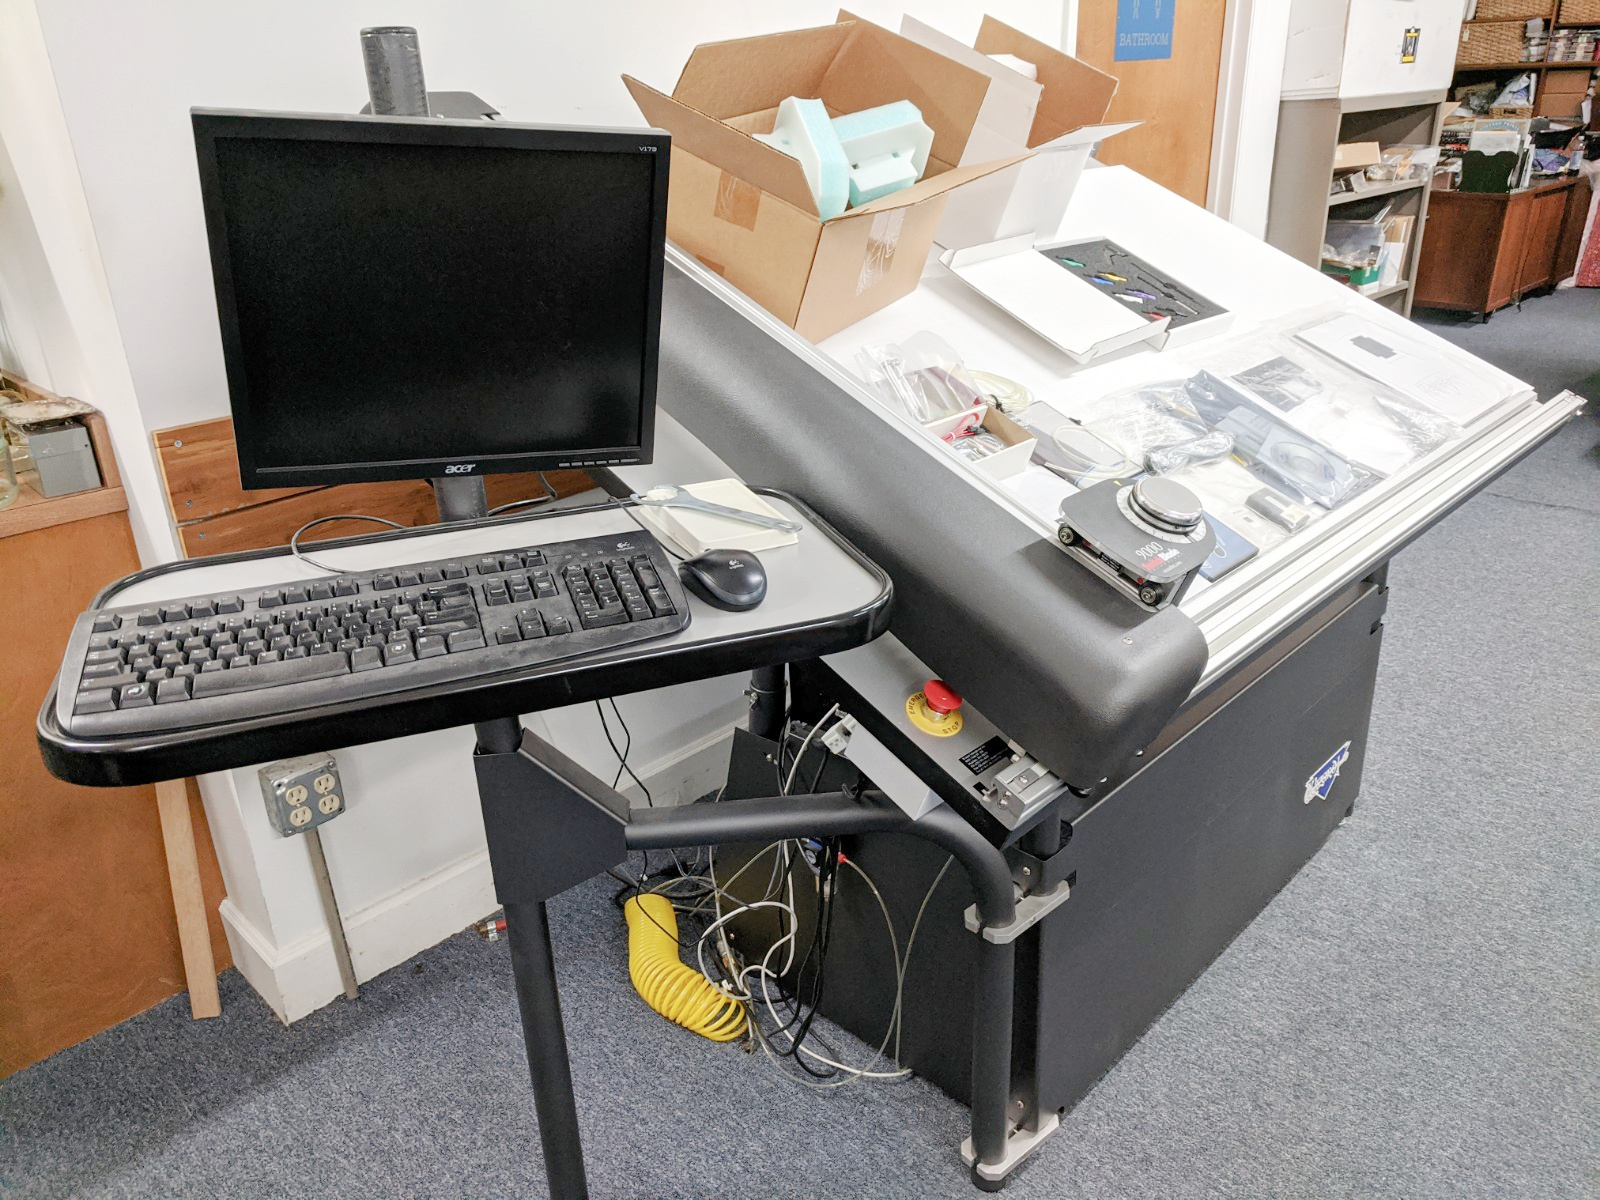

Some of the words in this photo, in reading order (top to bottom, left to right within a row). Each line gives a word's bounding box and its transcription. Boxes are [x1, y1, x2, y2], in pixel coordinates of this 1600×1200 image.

[1119, 32, 1169, 46] BATHROOM
[445, 463, 476, 474] acer
[1135, 541, 1164, 560] 9000
[908, 693, 925, 715] EMERGE
[942, 721, 960, 734] STOP
